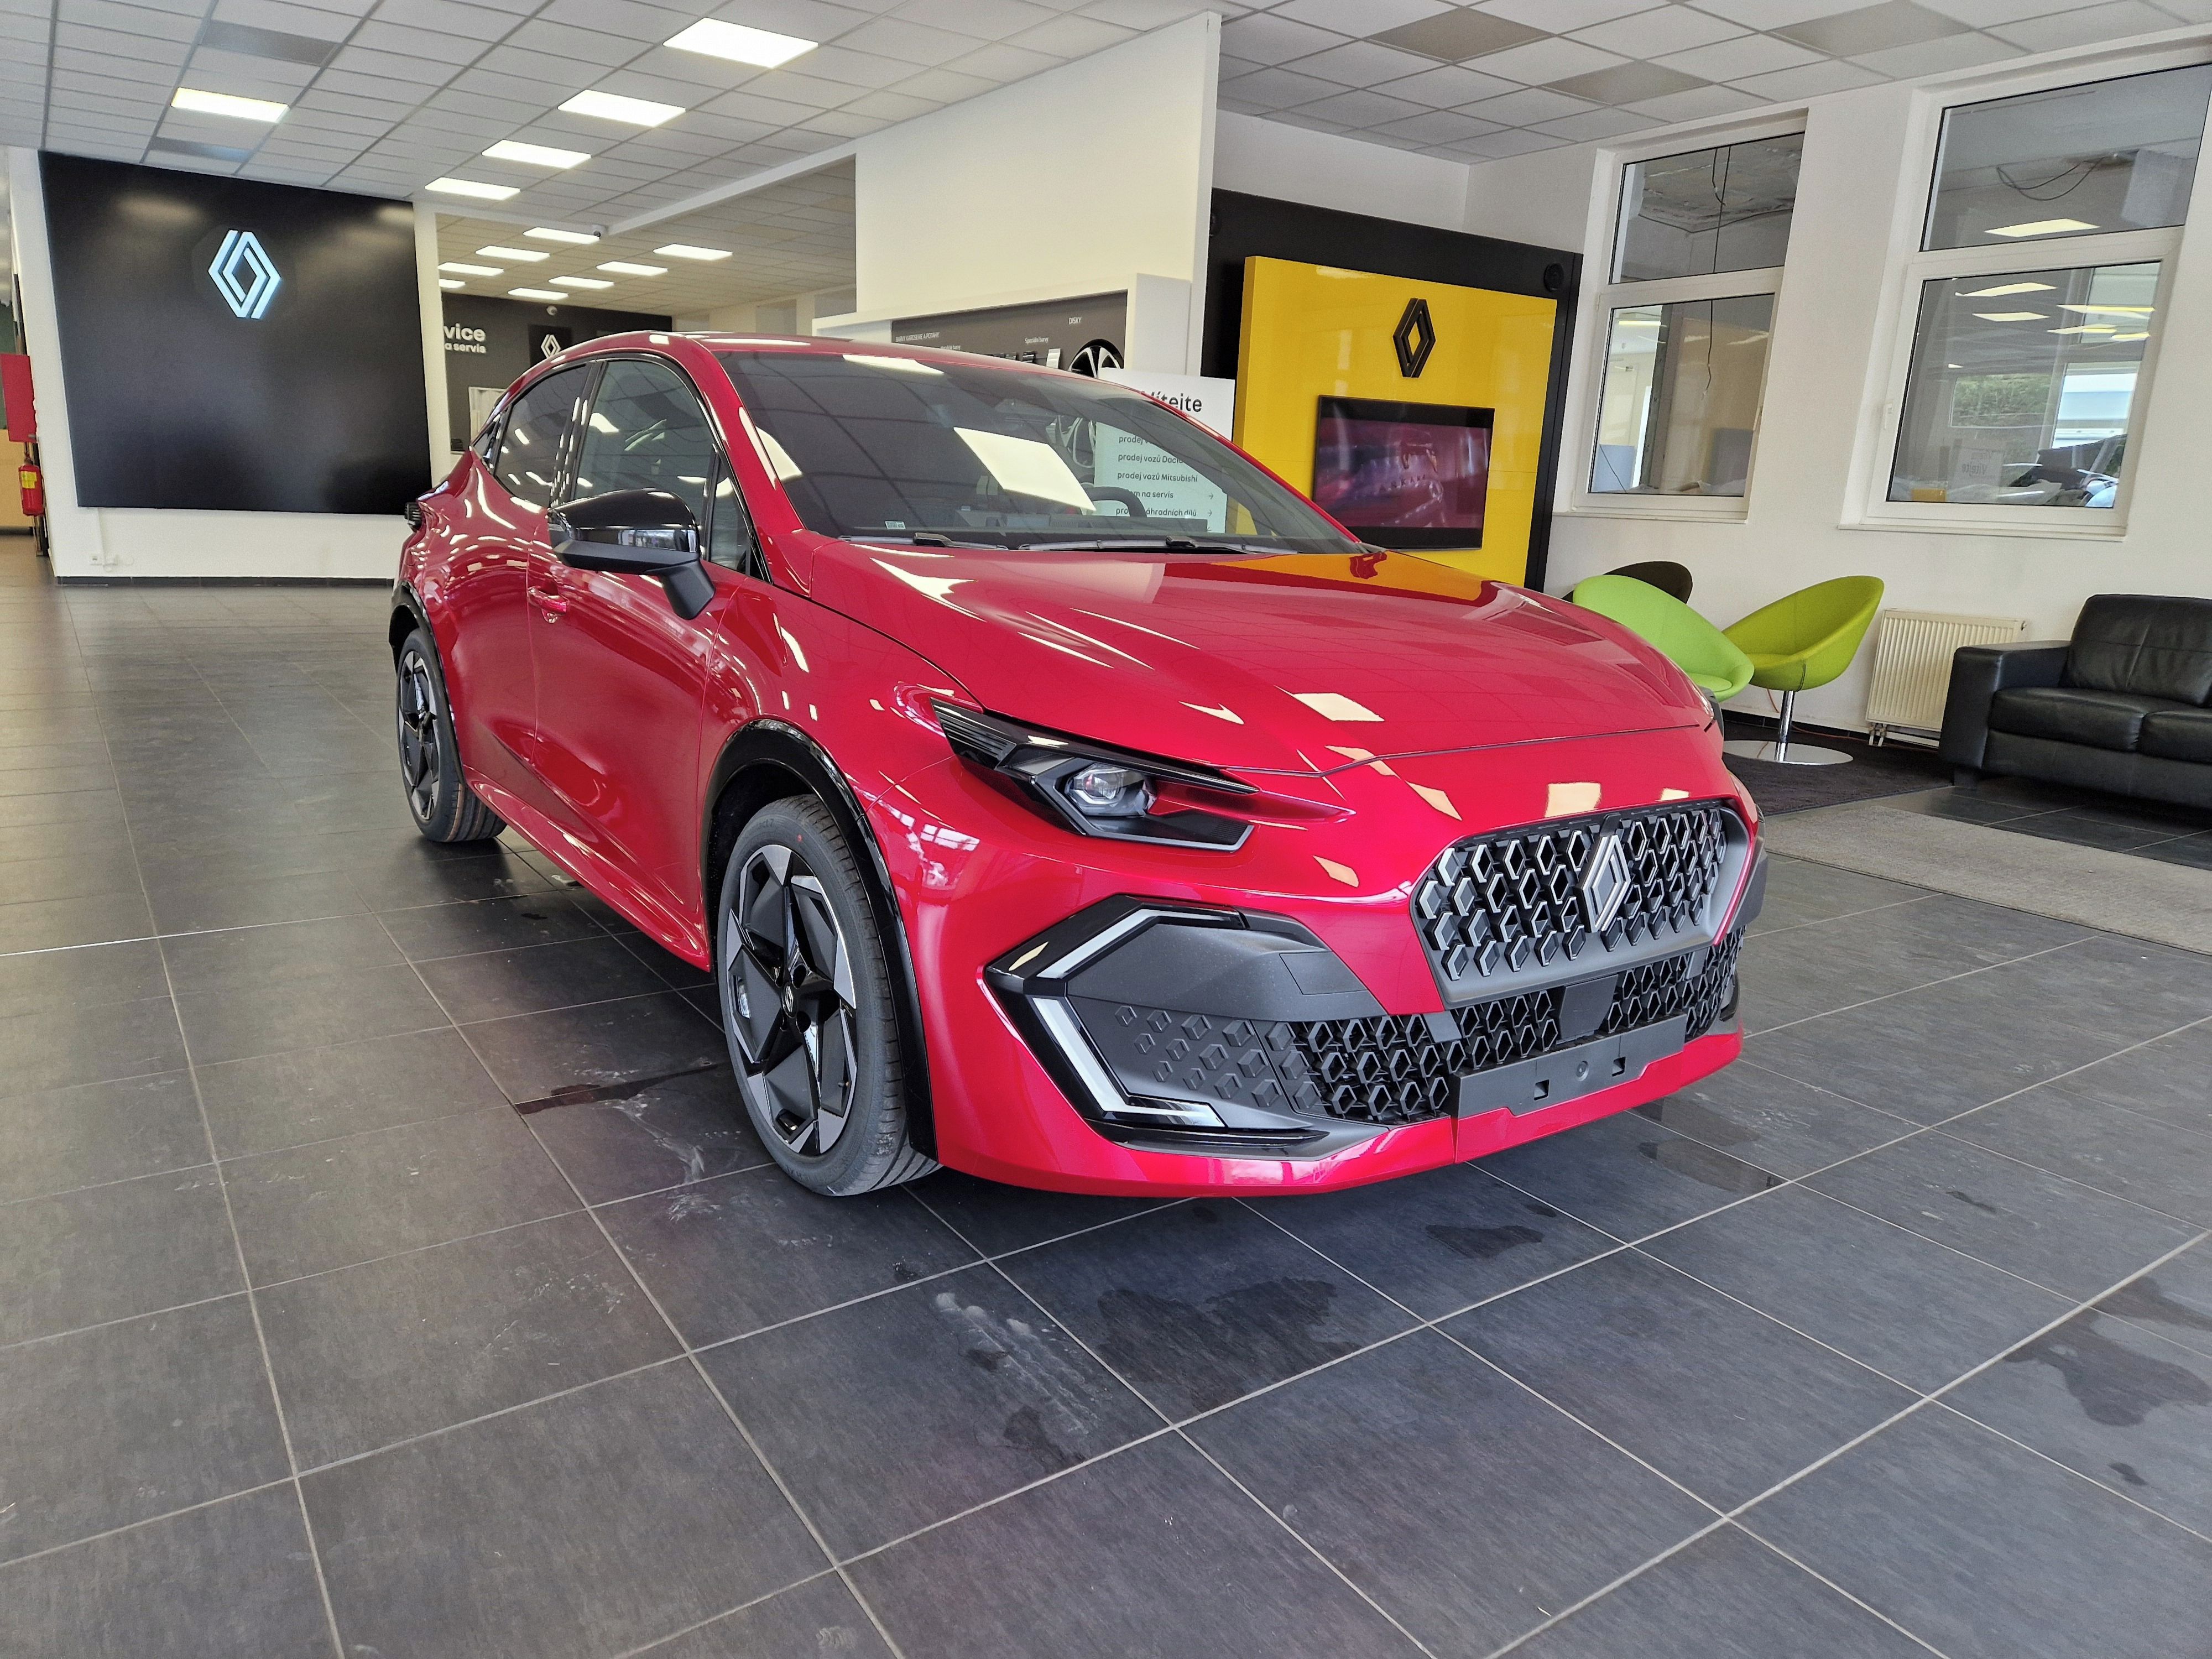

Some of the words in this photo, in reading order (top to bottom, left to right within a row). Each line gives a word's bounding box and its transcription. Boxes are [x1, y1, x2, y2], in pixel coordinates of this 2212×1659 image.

[453, 343, 486, 353] servis
[1119, 436, 1143, 445] prodej
[1118, 453, 1142, 463] prodej
[1144, 454, 1161, 463] vozů
[1117, 472, 1141, 481] prodej
[1161, 474, 1198, 482] Mitsubishi
[1146, 507, 1183, 516] áhradních
